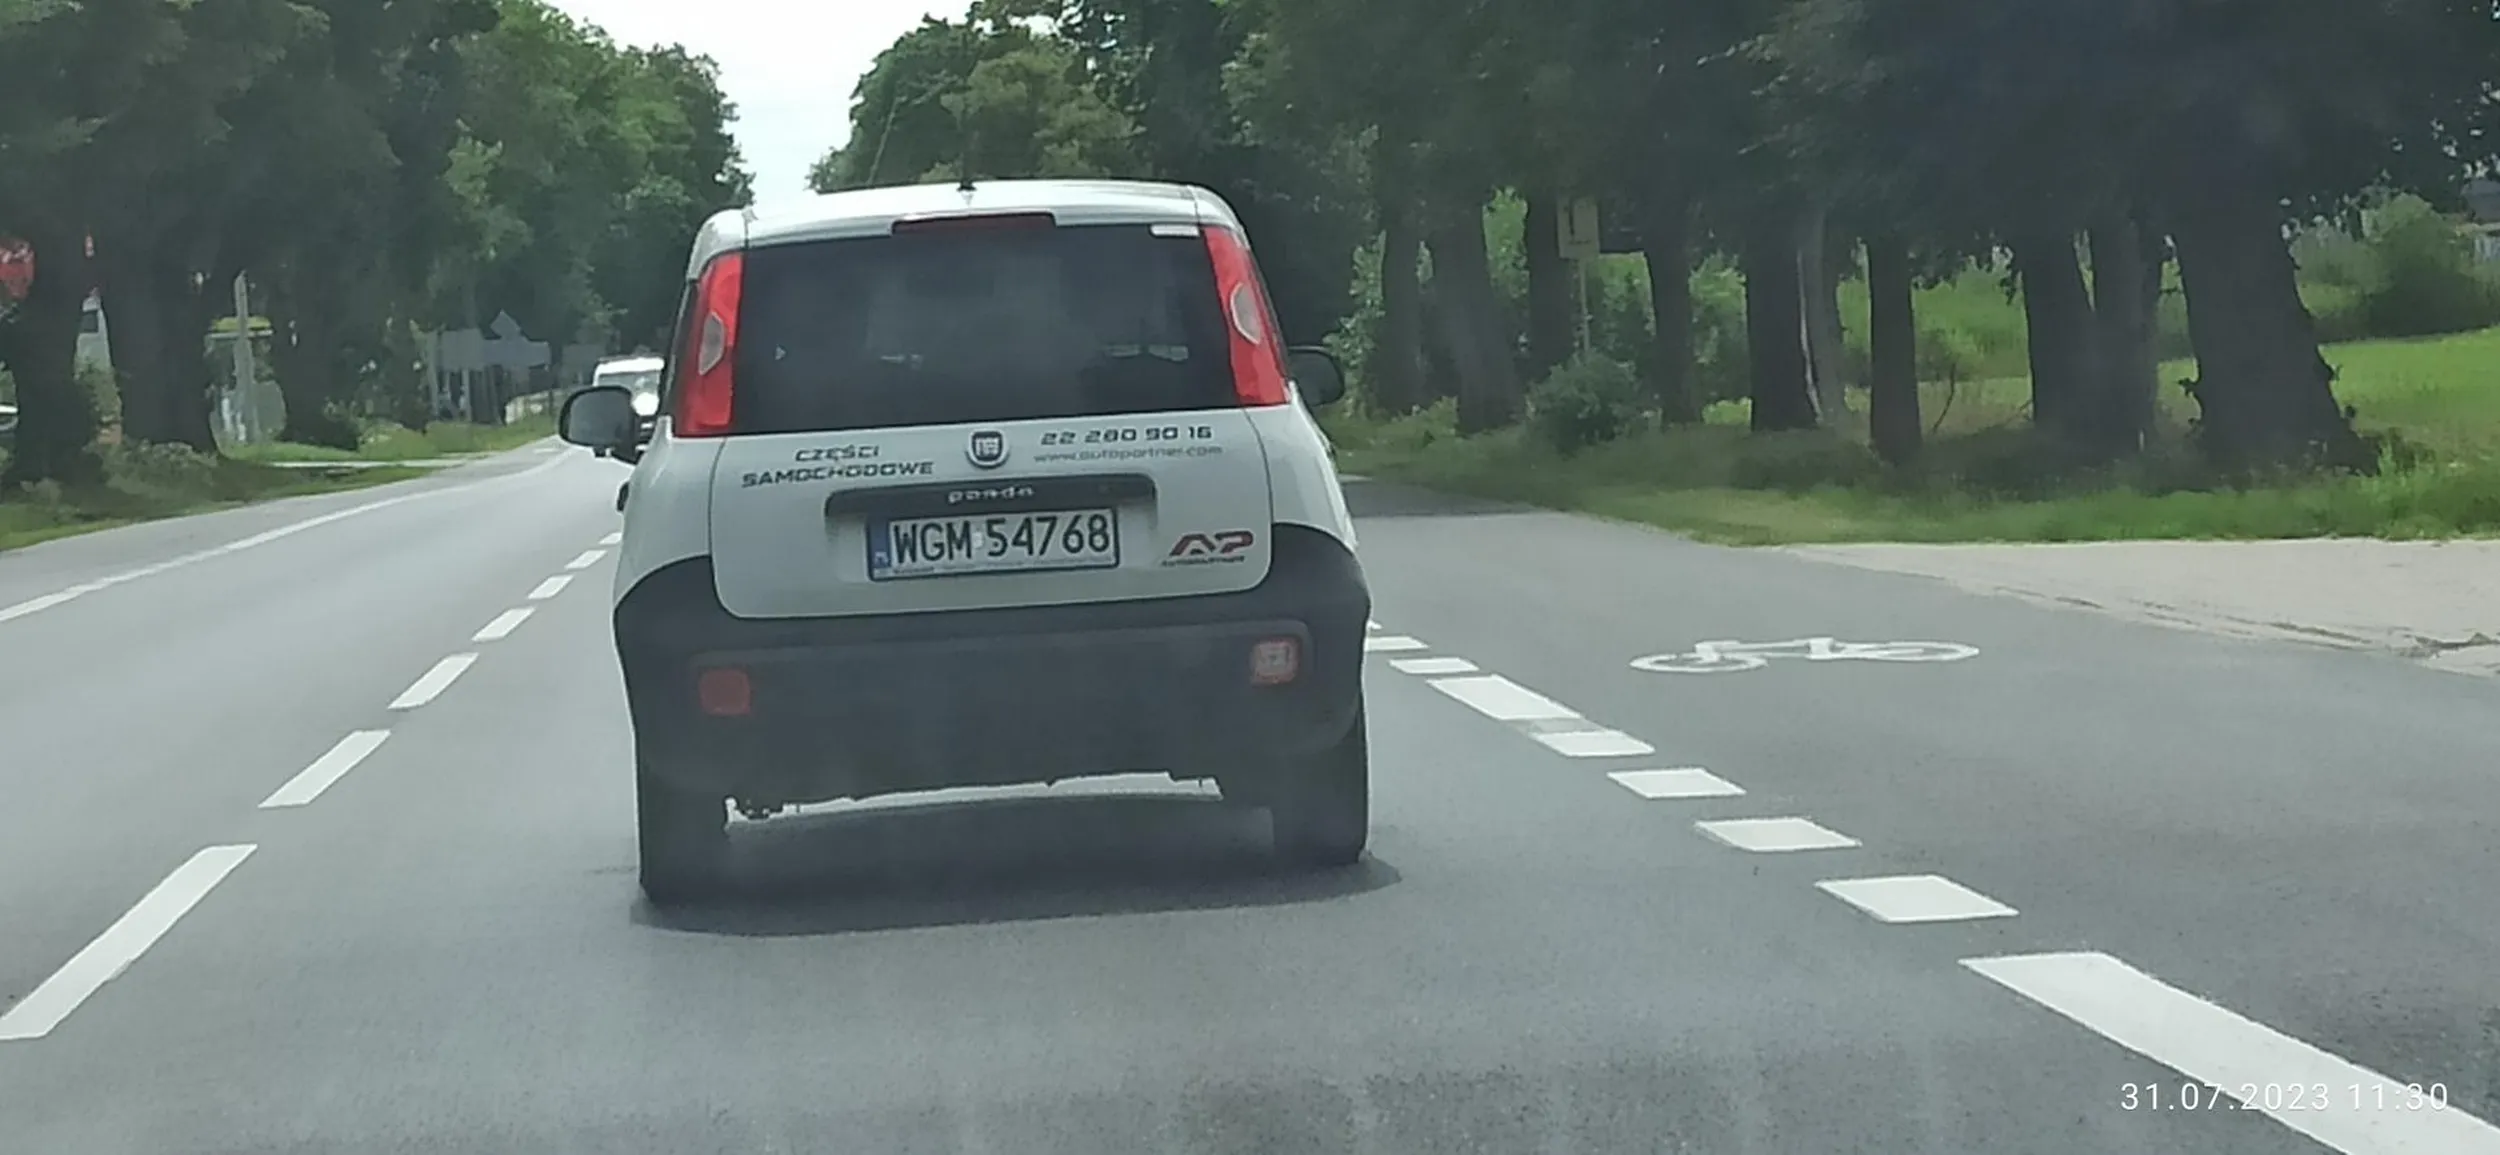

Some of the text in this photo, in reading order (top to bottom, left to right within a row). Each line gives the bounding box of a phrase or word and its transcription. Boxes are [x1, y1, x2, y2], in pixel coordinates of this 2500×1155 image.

[1041, 431, 1076, 446] 22
[1084, 428, 1137, 444] 280
[741, 461, 934, 489] SAMOCHODOWE
[893, 513, 1110, 564] WGM 54768
